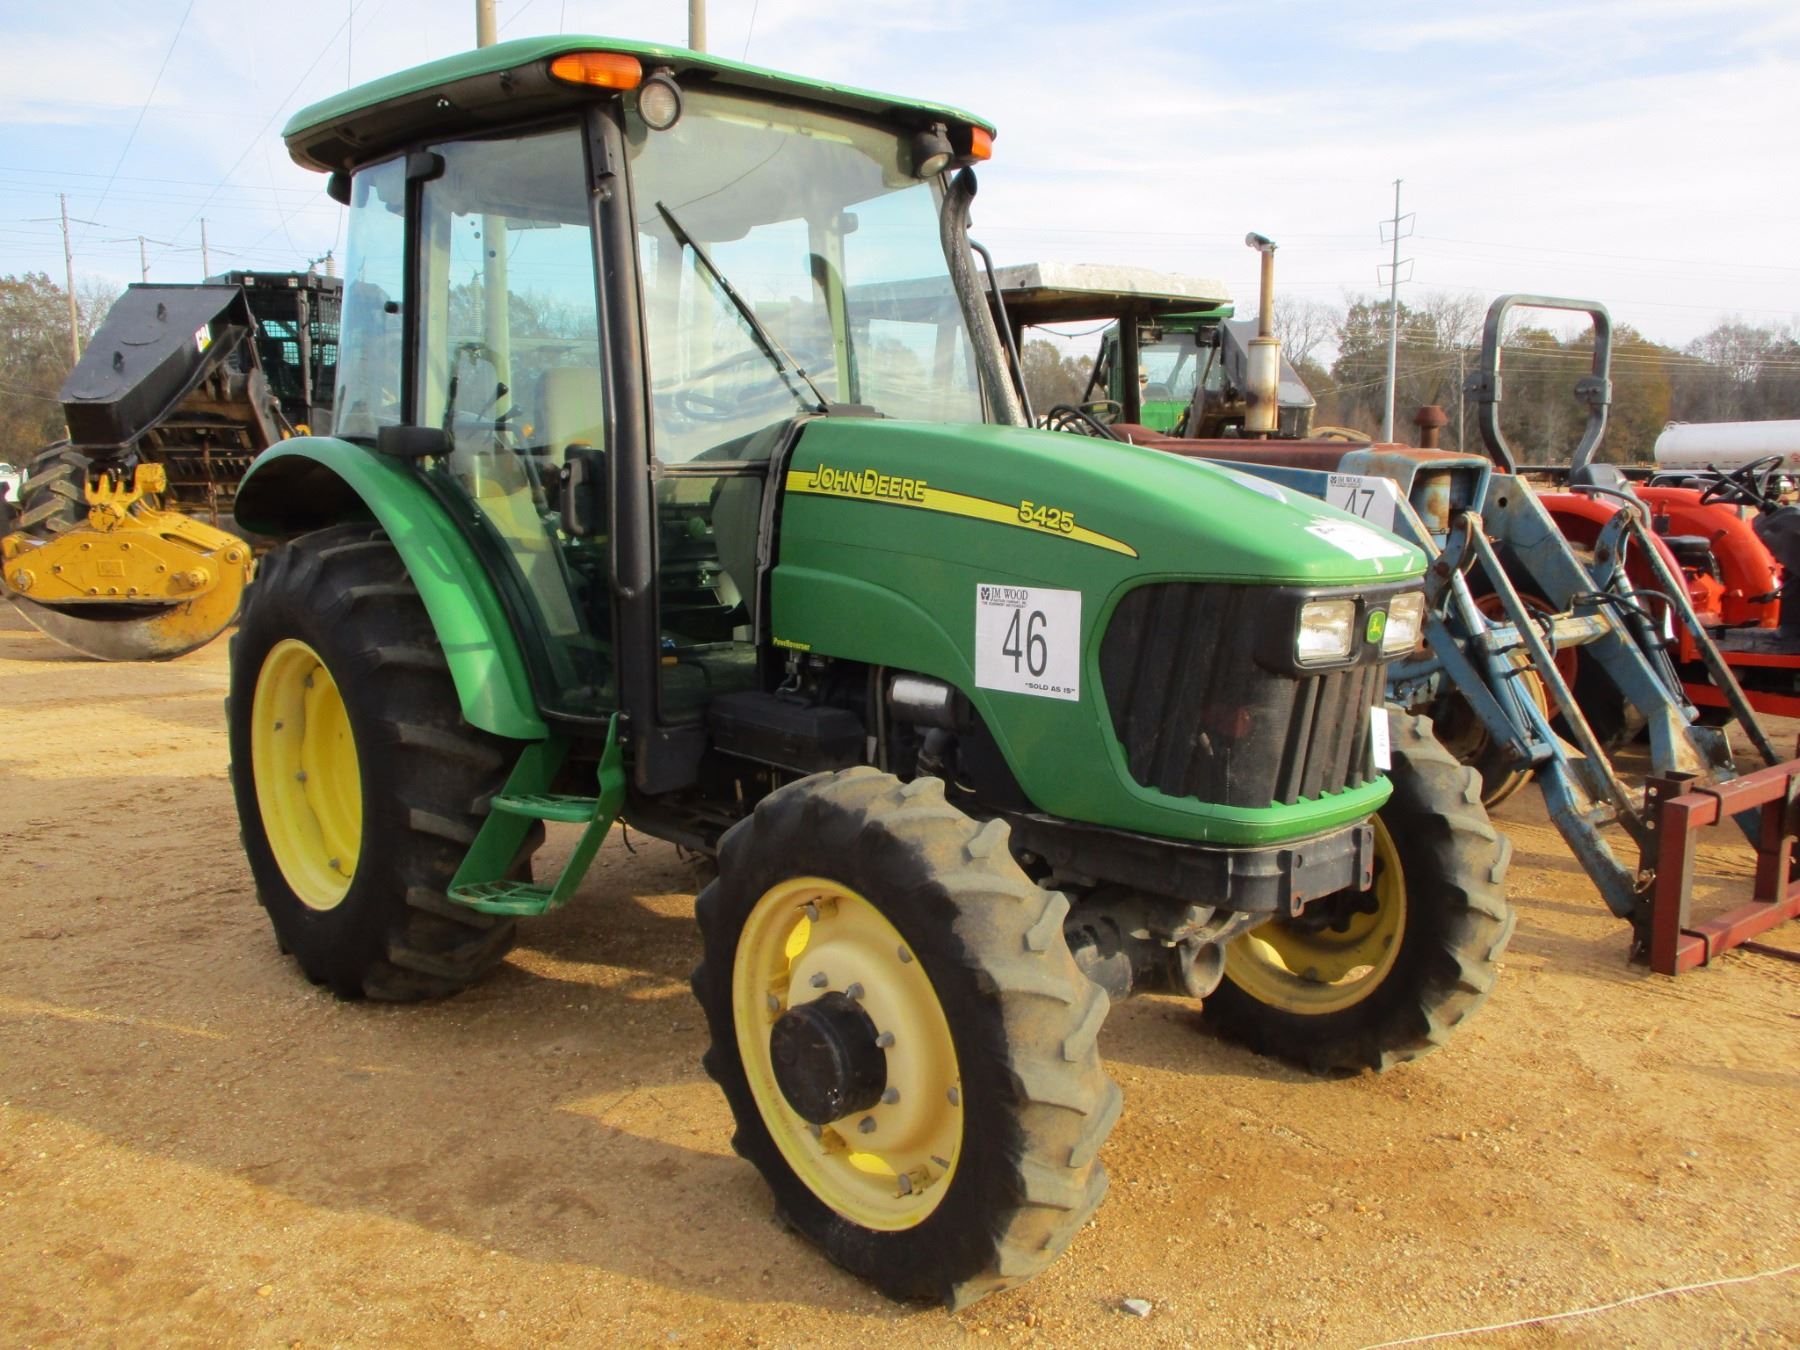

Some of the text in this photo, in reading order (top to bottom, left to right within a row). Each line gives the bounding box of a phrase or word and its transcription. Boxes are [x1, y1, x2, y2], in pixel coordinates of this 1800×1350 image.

[1019, 499, 1074, 533] 5425
[991, 587, 1029, 601] JM WOOD
[1002, 608, 1048, 677] 46
[1051, 686, 1062, 694] AS
